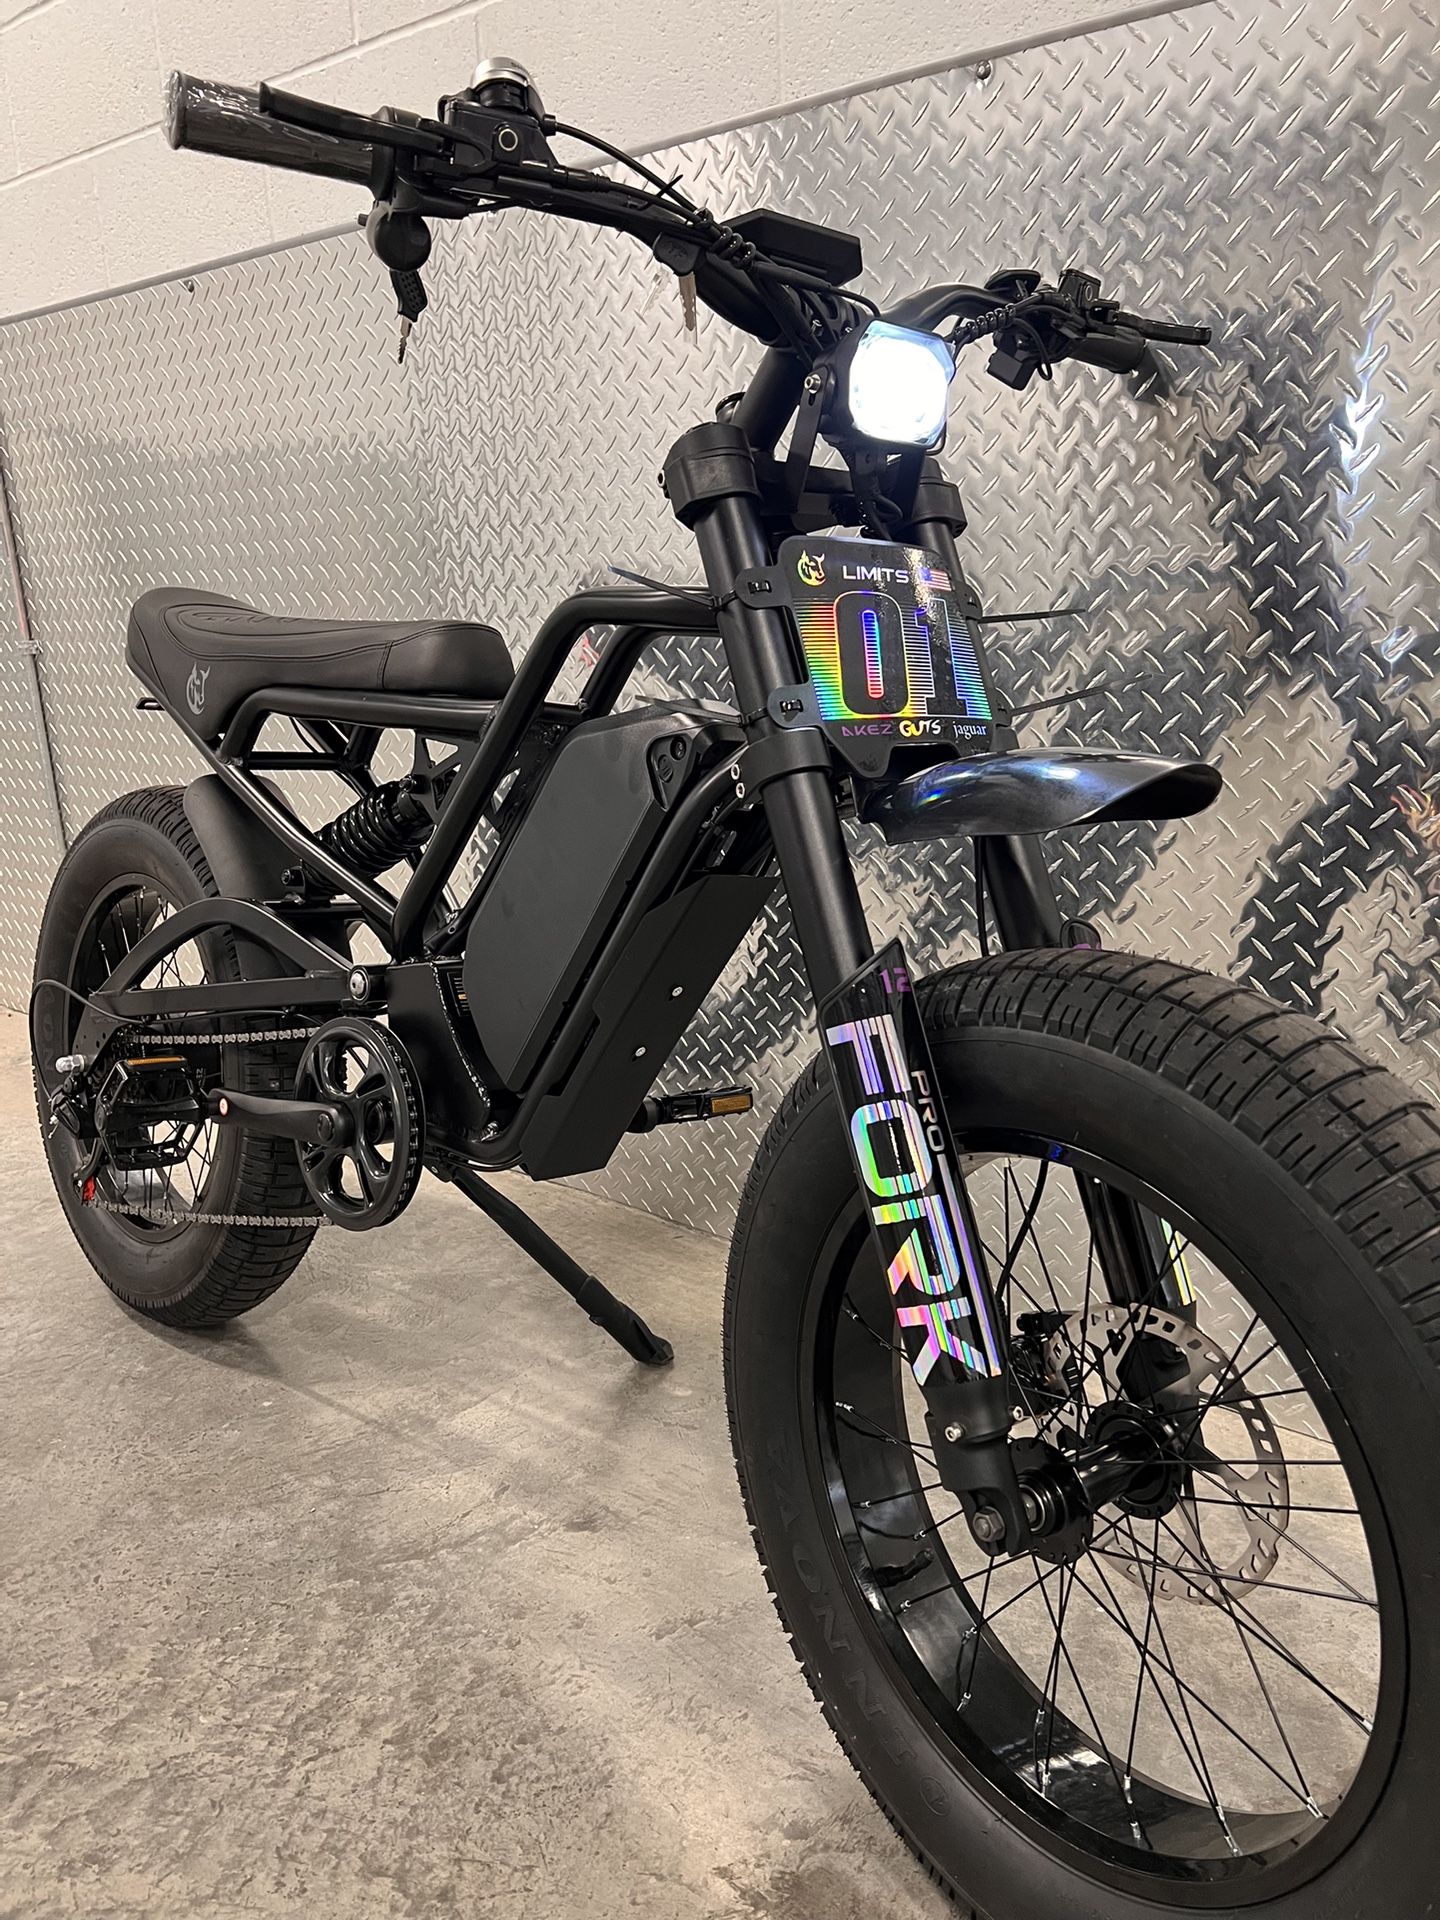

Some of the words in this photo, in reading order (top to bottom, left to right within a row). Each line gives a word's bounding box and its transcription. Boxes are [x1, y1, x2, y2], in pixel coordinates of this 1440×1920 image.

[843, 565, 910, 584] LIMITS
[899, 719, 942, 738] GUTS
[952, 720, 987, 740] jaguar
[910, 1069, 947, 1154] PRO
[826, 1013, 988, 1387] FORK
